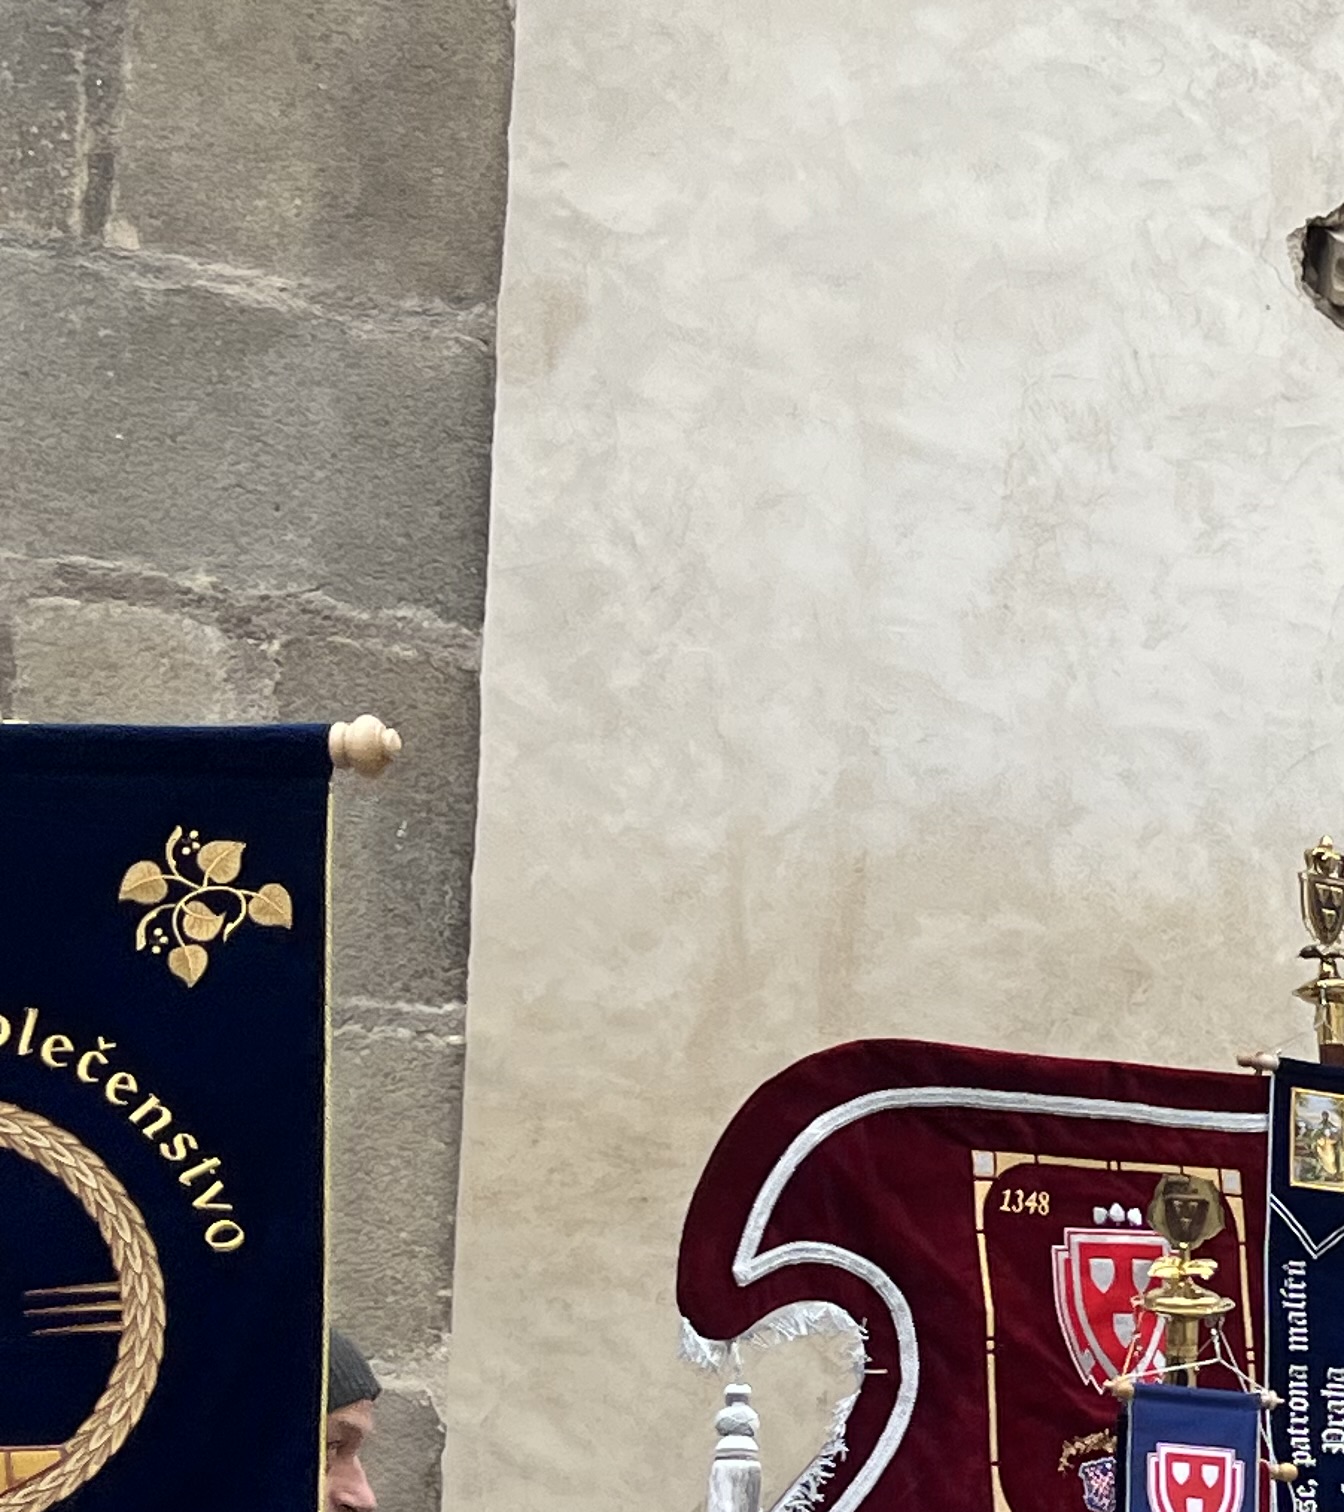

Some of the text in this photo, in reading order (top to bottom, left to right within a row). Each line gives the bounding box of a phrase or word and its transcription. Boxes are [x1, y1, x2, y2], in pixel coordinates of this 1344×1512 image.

[999, 1188, 1051, 1216] 1348
[1279, 1259, 1309, 1352] malířů
[1286, 1364, 1317, 1468] patrona
